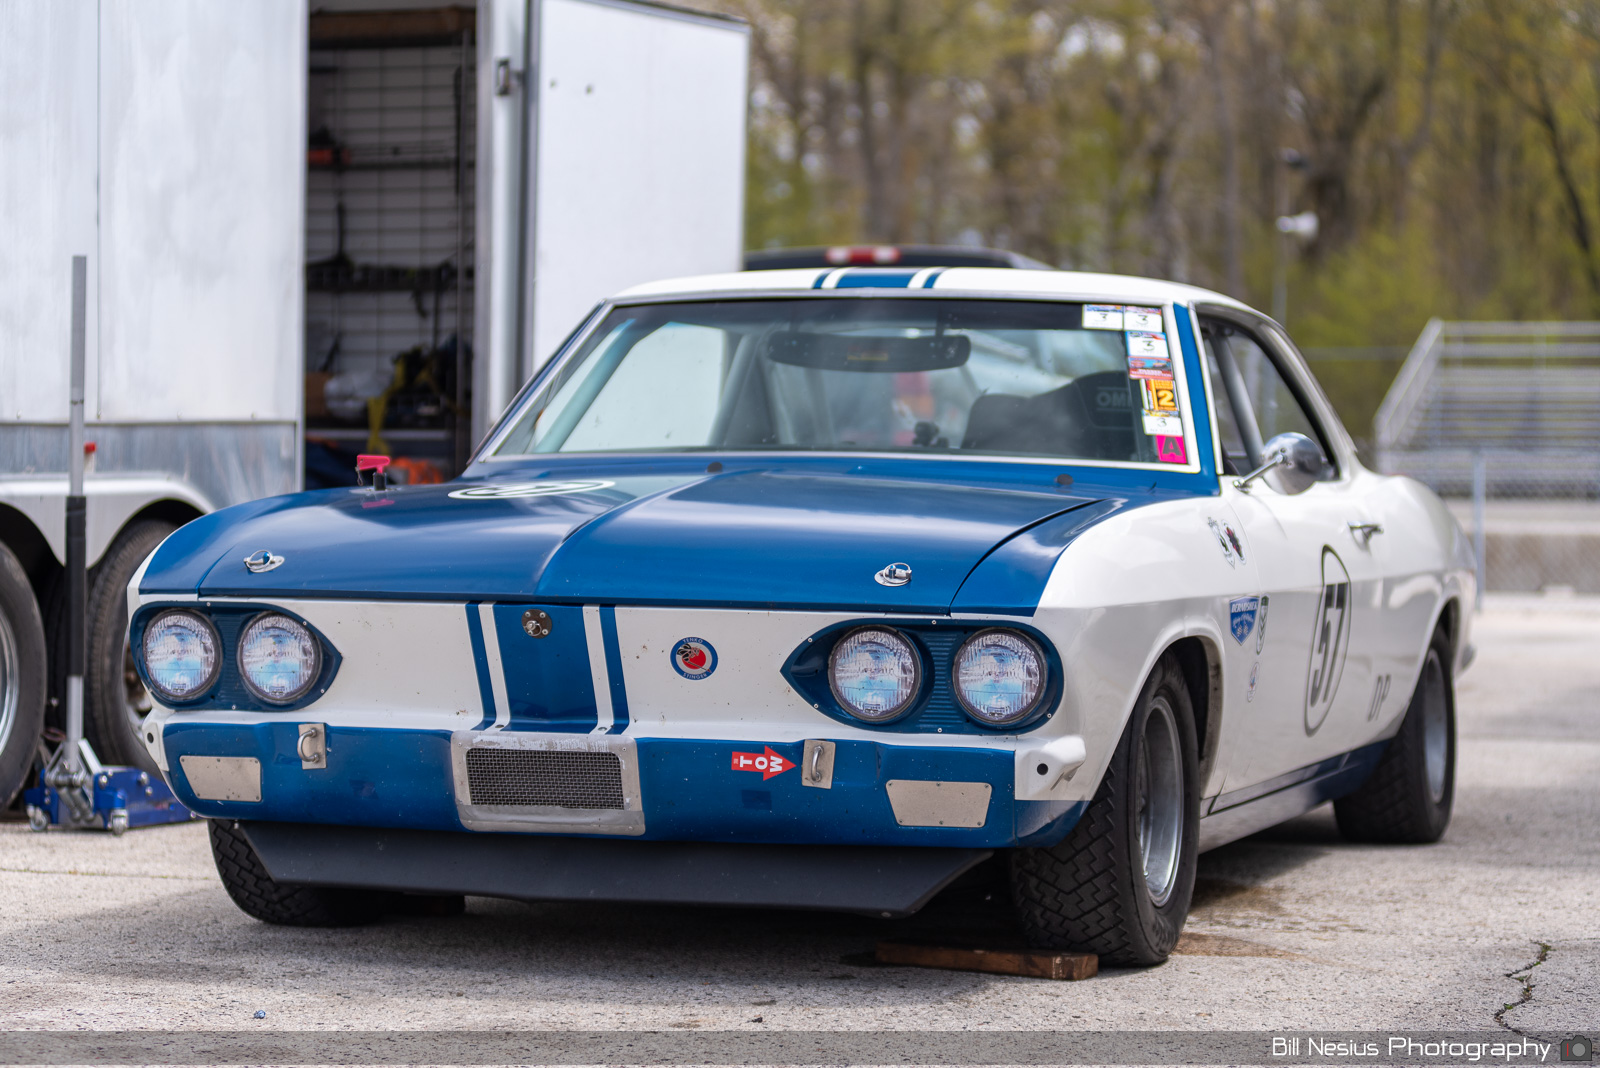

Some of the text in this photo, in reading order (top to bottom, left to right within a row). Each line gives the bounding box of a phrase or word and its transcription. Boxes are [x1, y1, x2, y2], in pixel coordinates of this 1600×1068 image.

[1136, 314, 1149, 325] 3
[1142, 340, 1155, 351] 3
[1157, 390, 1176, 407] 2
[1157, 417, 1168, 428] 3
[1162, 436, 1183, 456] A
[1311, 582, 1349, 708] 57
[683, 672, 707, 680] STINGER
[739, 755, 783, 773] TOW
